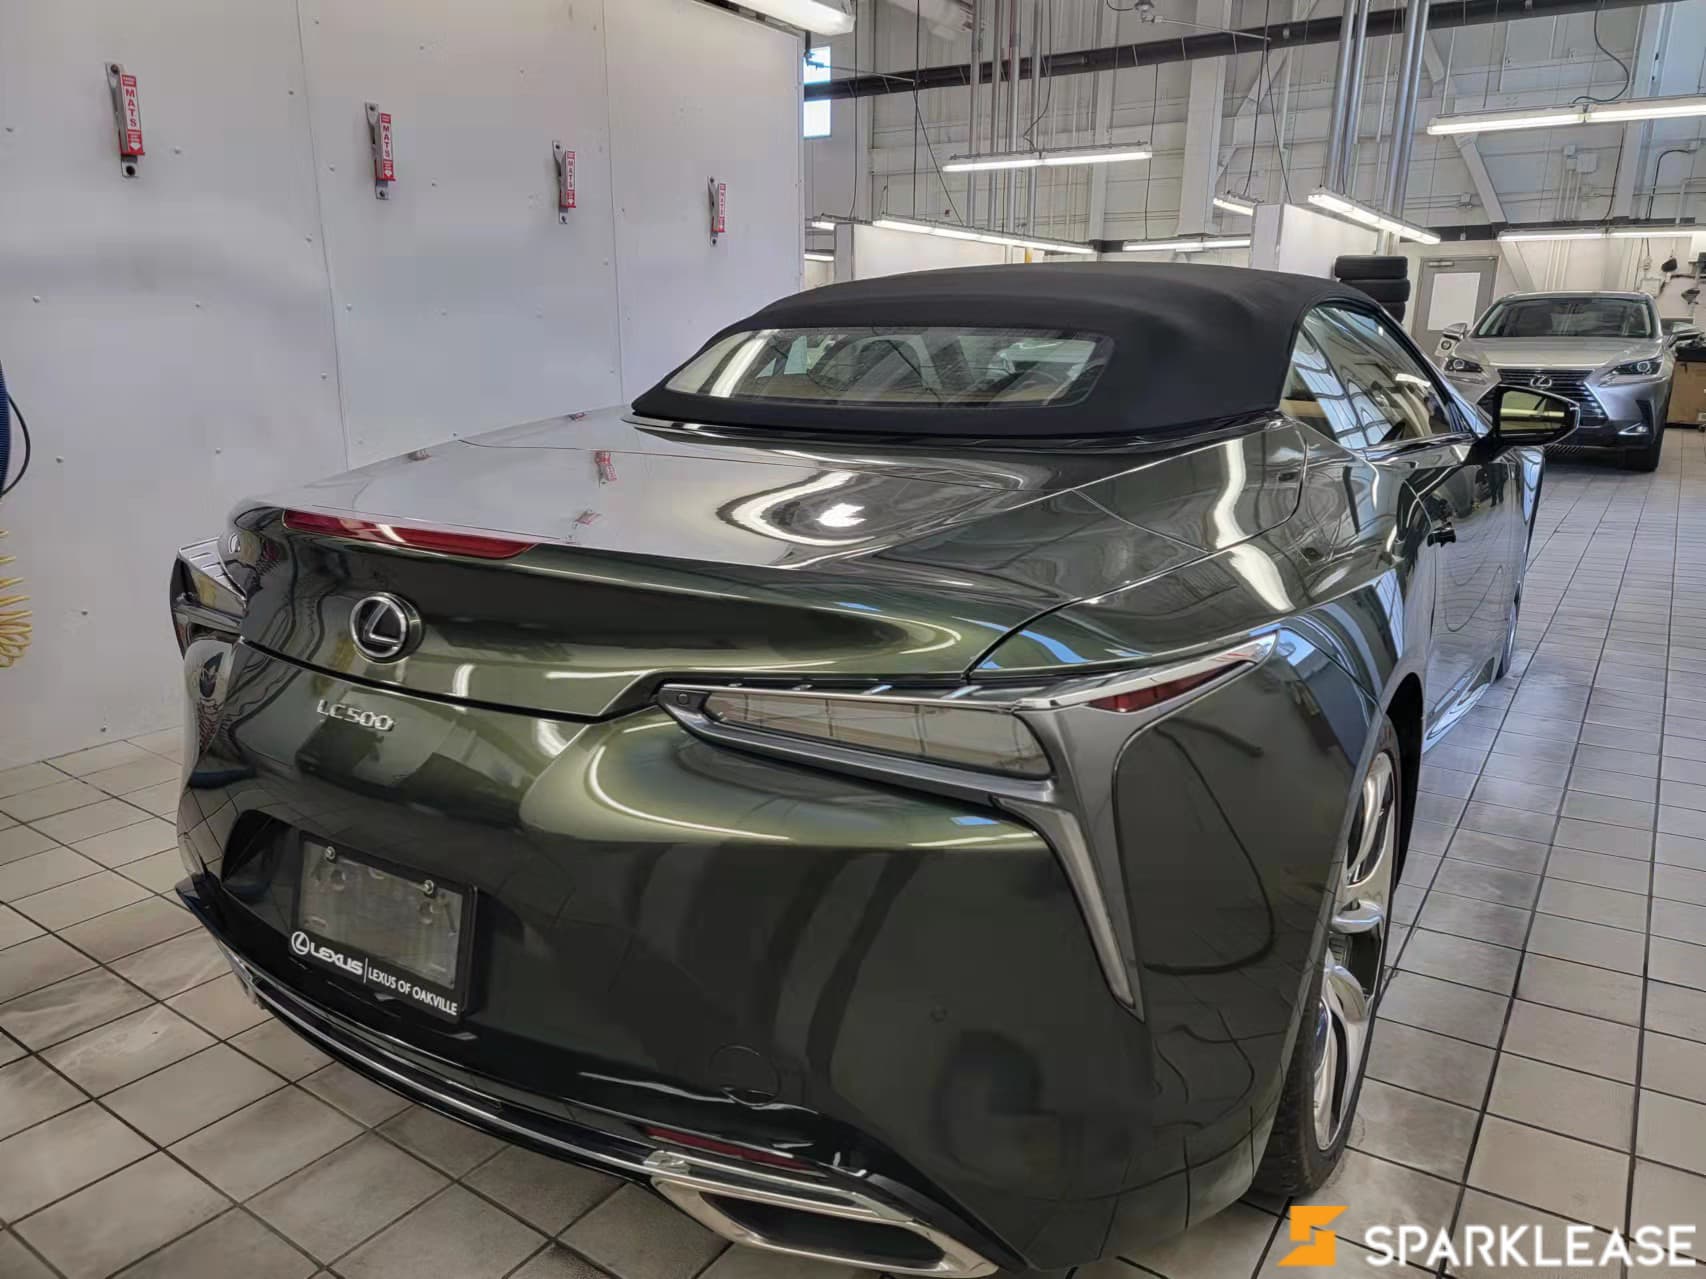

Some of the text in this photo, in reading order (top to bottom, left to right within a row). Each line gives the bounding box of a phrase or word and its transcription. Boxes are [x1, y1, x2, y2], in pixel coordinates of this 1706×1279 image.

[125, 88, 137, 127] MATS
[382, 125, 391, 159] MATS
[310, 942, 364, 976] LEXUS
[368, 968, 458, 1016] LEXUS OF OAKVILLE
